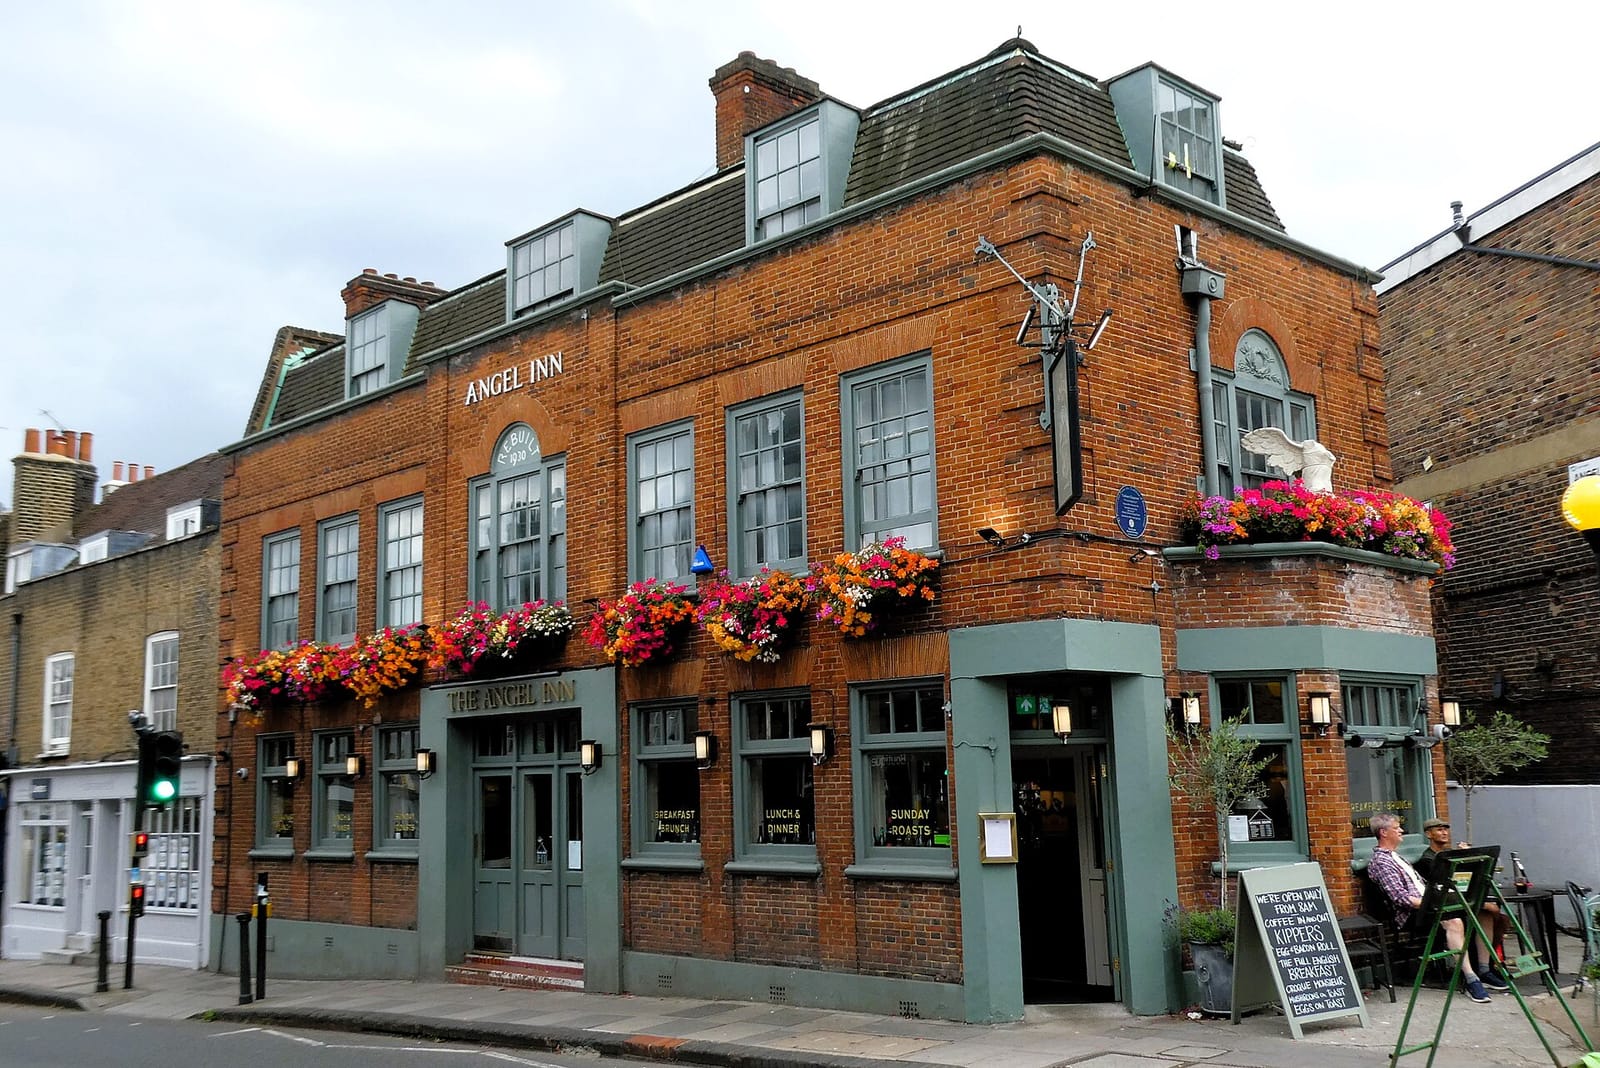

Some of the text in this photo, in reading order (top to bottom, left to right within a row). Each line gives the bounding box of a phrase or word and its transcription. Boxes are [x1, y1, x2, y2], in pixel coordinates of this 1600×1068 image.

[465, 352, 563, 406] ANGEL INN
[497, 430, 541, 465] REBUILT
[510, 450, 527, 466] 1930
[447, 680, 576, 712] THE ANGEL INN
[655, 810, 695, 819] BREAKFAST
[766, 809, 801, 819] LUNCH &
[891, 809, 930, 820] SUNDAY
[660, 824, 690, 834] BRUNCH
[767, 824, 800, 834] DINNER
[892, 825, 931, 836] ROASTS
[1281, 891, 1304, 903] OPEN
[1304, 888, 1323, 900] DAILY
[1274, 901, 1318, 914] FROM 8AM
[1264, 917, 1295, 928] COFFEE
[1316, 912, 1330, 923] OUT
[1274, 925, 1325, 945] KIPPERS
[1293, 943, 1316, 955] BACON
[1316, 942, 1339, 952] ROLL
[1278, 954, 1341, 968] THE FULL ENGLISH
[1287, 964, 1338, 981] BREAKFAST
[1285, 975, 1347, 994] CROQUE MONSIEUR
[1326, 987, 1346, 998] TOAST
[1293, 997, 1346, 1016] EGGS ON TOAST
